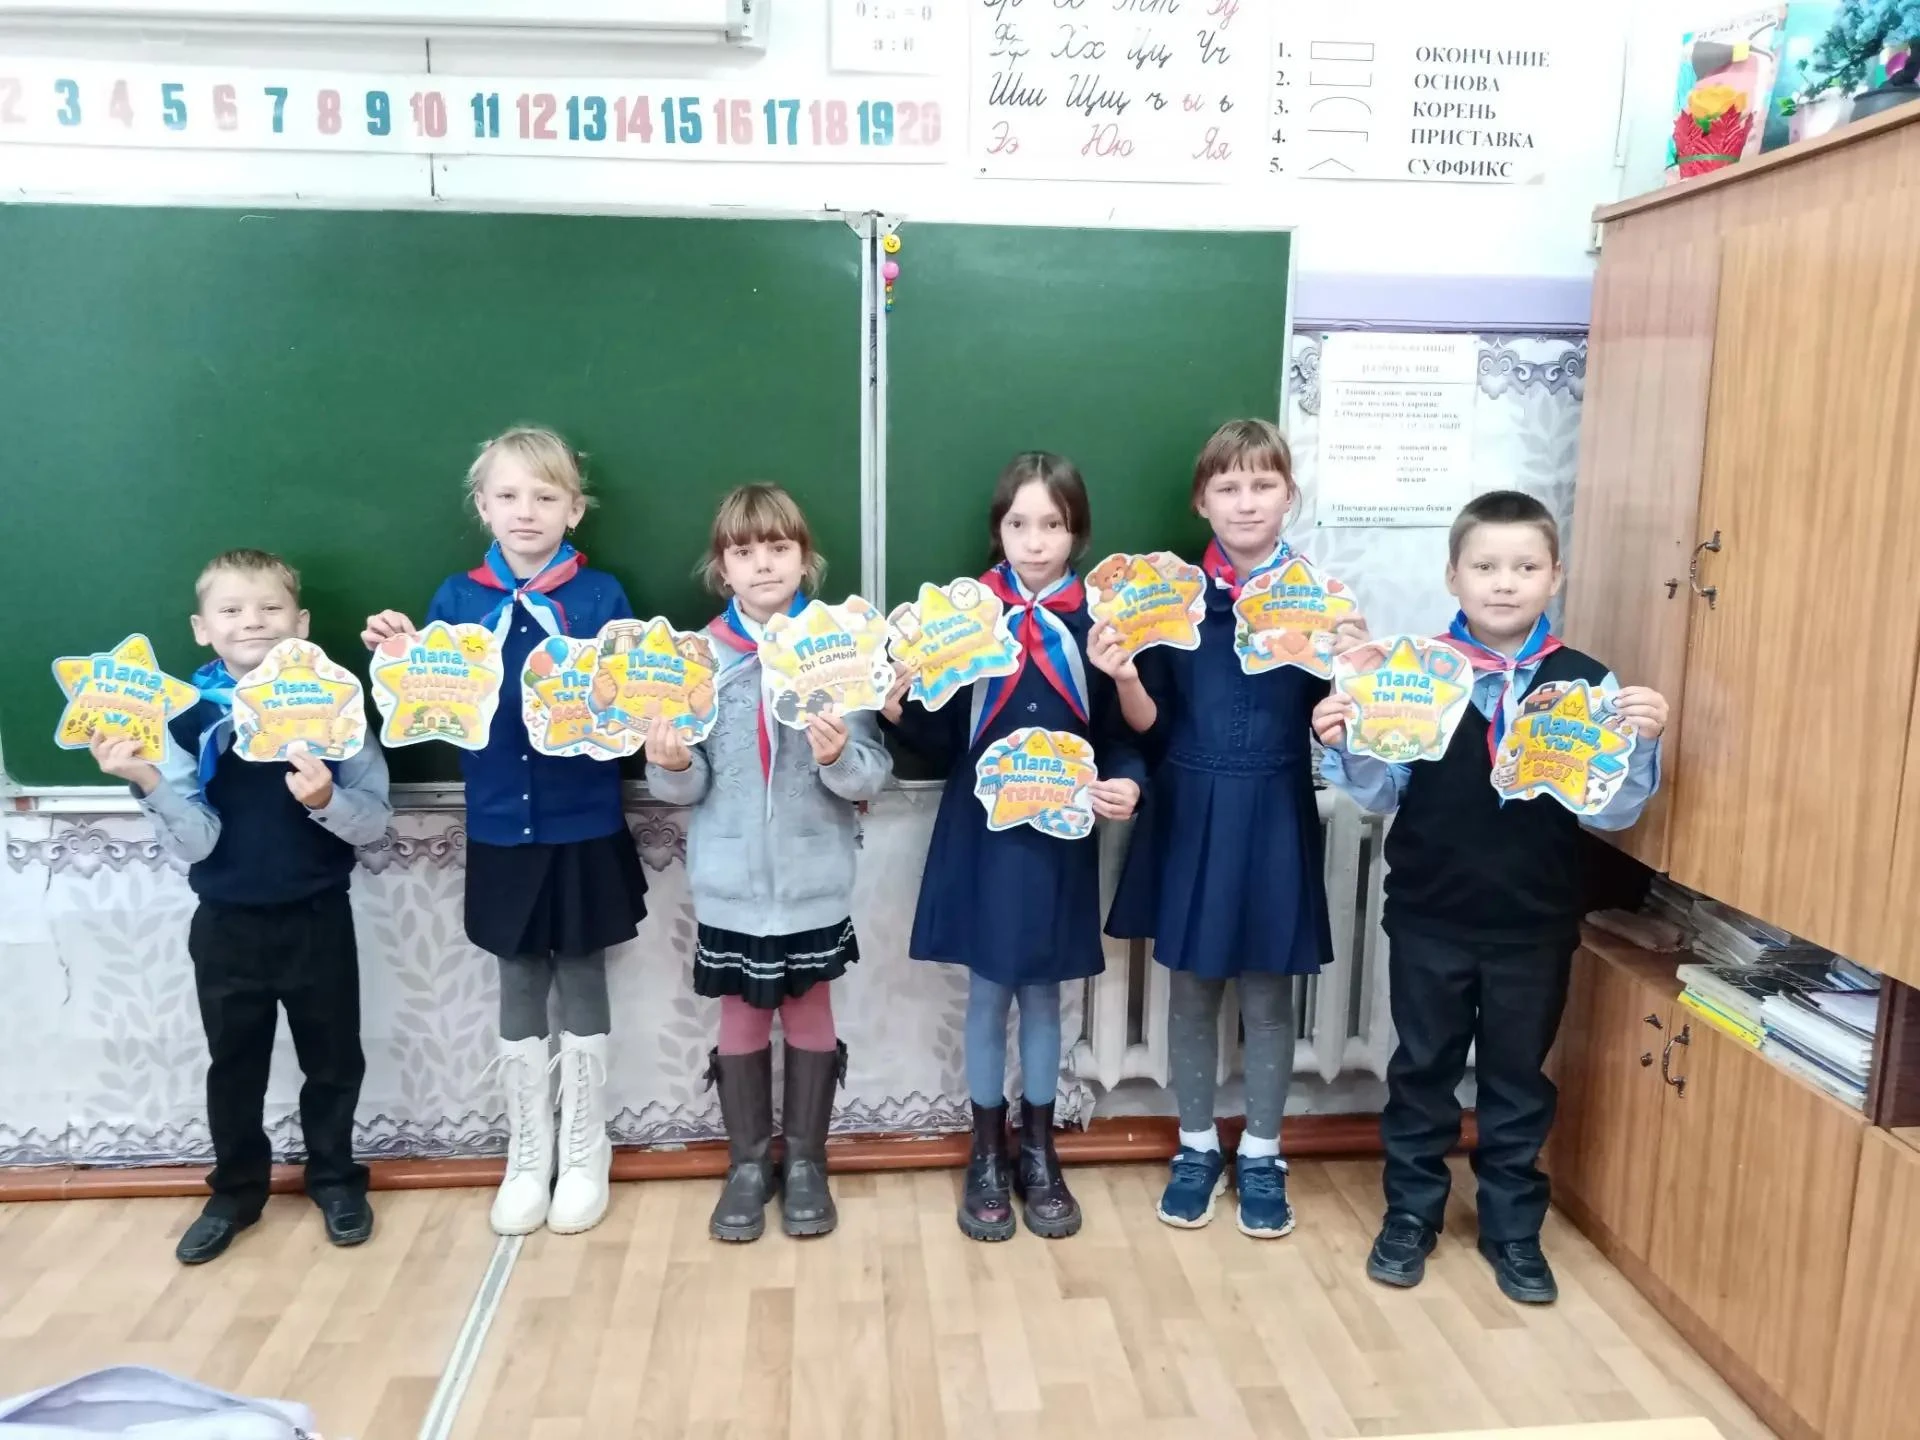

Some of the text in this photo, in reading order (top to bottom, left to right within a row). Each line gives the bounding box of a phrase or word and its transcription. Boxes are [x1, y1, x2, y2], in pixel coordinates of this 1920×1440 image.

[1051, 23, 1106, 60] Хх
[1415, 45, 1551, 68] ОКОНЧАНИЕ
[1413, 72, 1500, 93] ОСНОВА
[988, 71, 1048, 107] Шш
[1065, 73, 1132, 118] Щщ
[54, 78, 82, 127] 3
[161, 82, 188, 132] 5
[212, 83, 239, 132] 6
[264, 86, 289, 134] 7
[317, 89, 343, 136] 8
[366, 90, 392, 137] 9
[409, 91, 448, 139] 10
[470, 92, 500, 139] 11
[516, 93, 558, 141] 12
[566, 95, 607, 142] 13
[613, 95, 654, 144] 14
[661, 96, 703, 145] 15
[712, 98, 753, 146] 16
[763, 99, 801, 147] 17
[808, 100, 849, 147] 18
[856, 100, 894, 148] 19
[896, 101, 943, 147] 20
[1411, 100, 1497, 121] КОРЕНЬ
[986, 120, 1233, 161] Ээ Юю Яя
[1410, 127, 1535, 150] ПРИСТАВКА
[1407, 158, 1514, 179] СУФФИКС
[1263, 599, 1328, 612] спасибо
[410, 646, 468, 667] Папа,
[793, 632, 858, 662] Папа,
[407, 666, 428, 676] ты
[798, 647, 858, 674] ты самый
[94, 656, 167, 695] Папа,
[1376, 669, 1434, 693] Папа,
[95, 681, 119, 694] ты
[1371, 690, 1434, 706] ты мой
[1530, 714, 1602, 750] Папа,
[1012, 752, 1067, 775] Папа,
[1002, 774, 1037, 785] рядом
[1046, 775, 1077, 788] тобой
